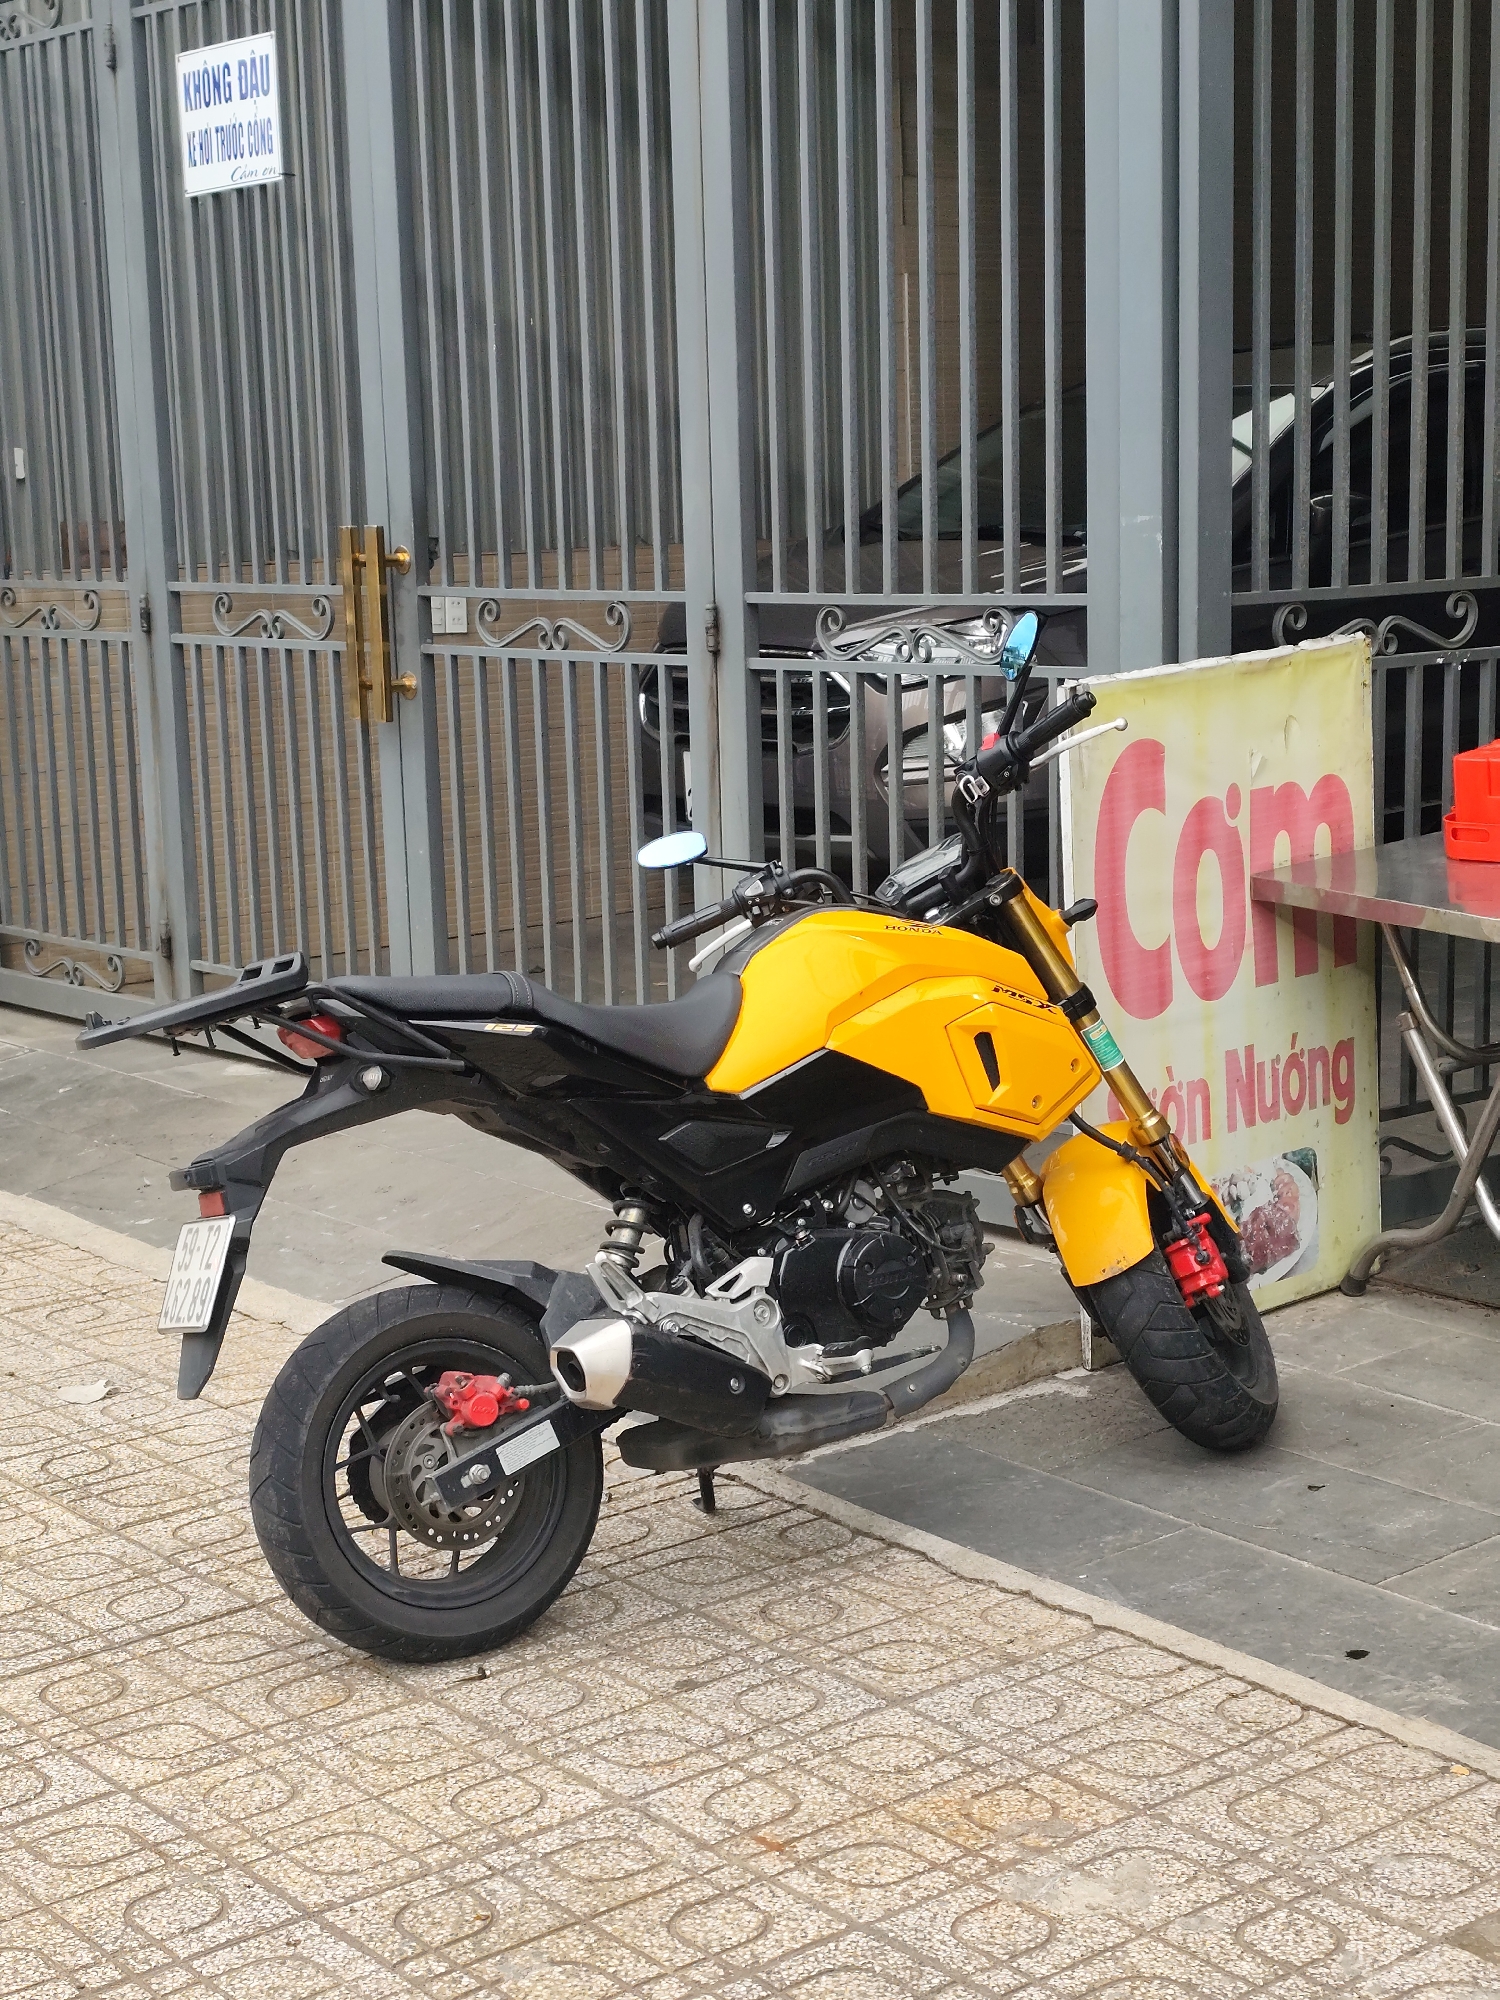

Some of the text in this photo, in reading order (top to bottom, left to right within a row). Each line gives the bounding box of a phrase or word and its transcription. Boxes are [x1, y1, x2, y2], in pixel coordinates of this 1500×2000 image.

[183, 49, 271, 112] KHÔNG ĐẬU
[187, 105, 274, 168] XE HƠI TRƯỚC CỔNG
[1094, 738, 1358, 1020] Cơm
[885, 923, 943, 936] HONDA
[991, 985, 1057, 1015] MSX
[1107, 1065, 1211, 1145] ờn
[1225, 1032, 1356, 1133] Nướng
[178, 1225, 221, 1272] 59-T2
[163, 1276, 212, 1325] 462.89
